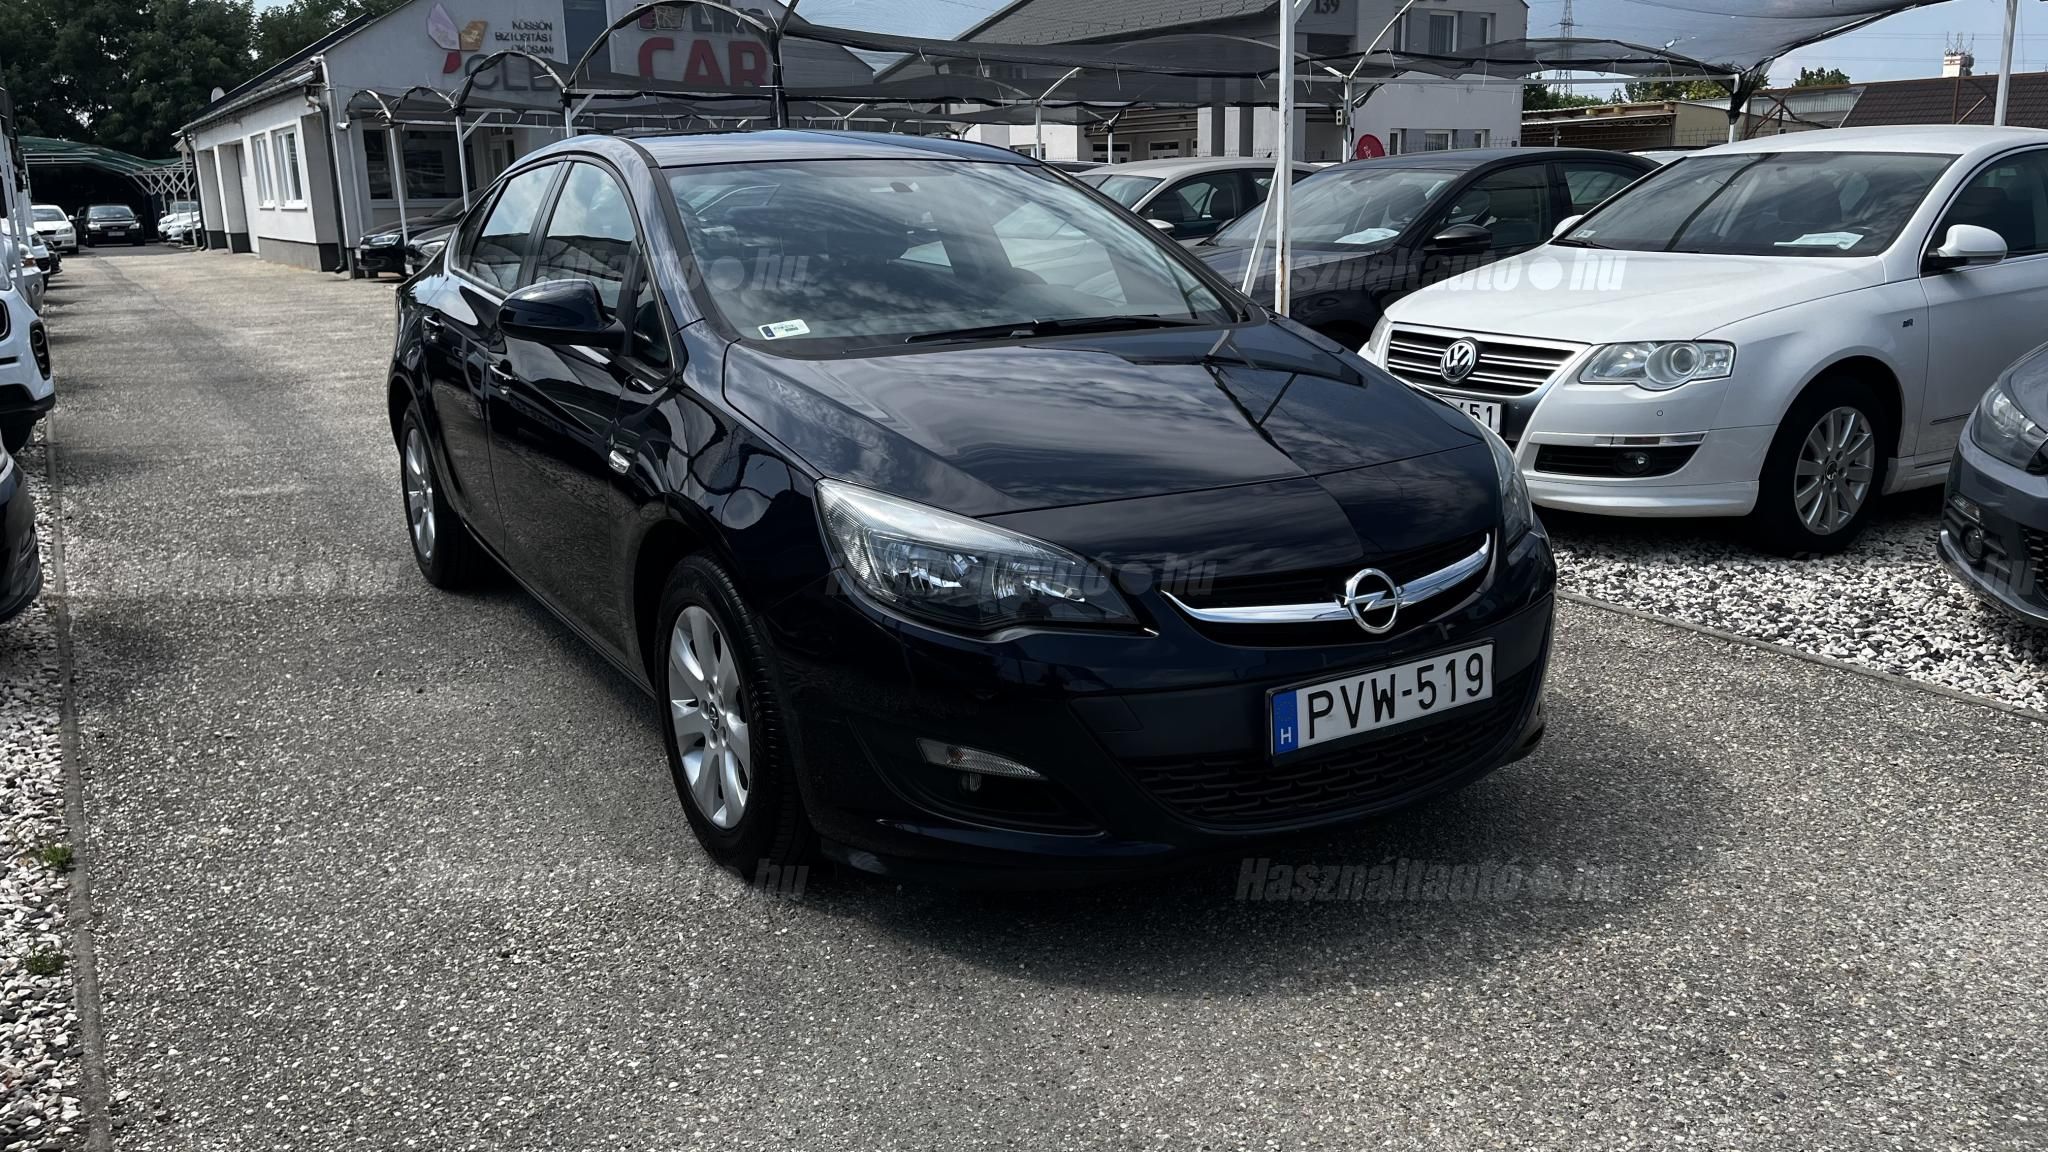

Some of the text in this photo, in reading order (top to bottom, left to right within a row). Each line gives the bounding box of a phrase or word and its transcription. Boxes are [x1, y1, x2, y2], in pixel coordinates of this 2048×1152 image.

[638, 37, 768, 88] CAR
[1460, 402, 1493, 428] 51
[1307, 652, 1484, 740] PVW-519
[1280, 726, 1292, 745] H
